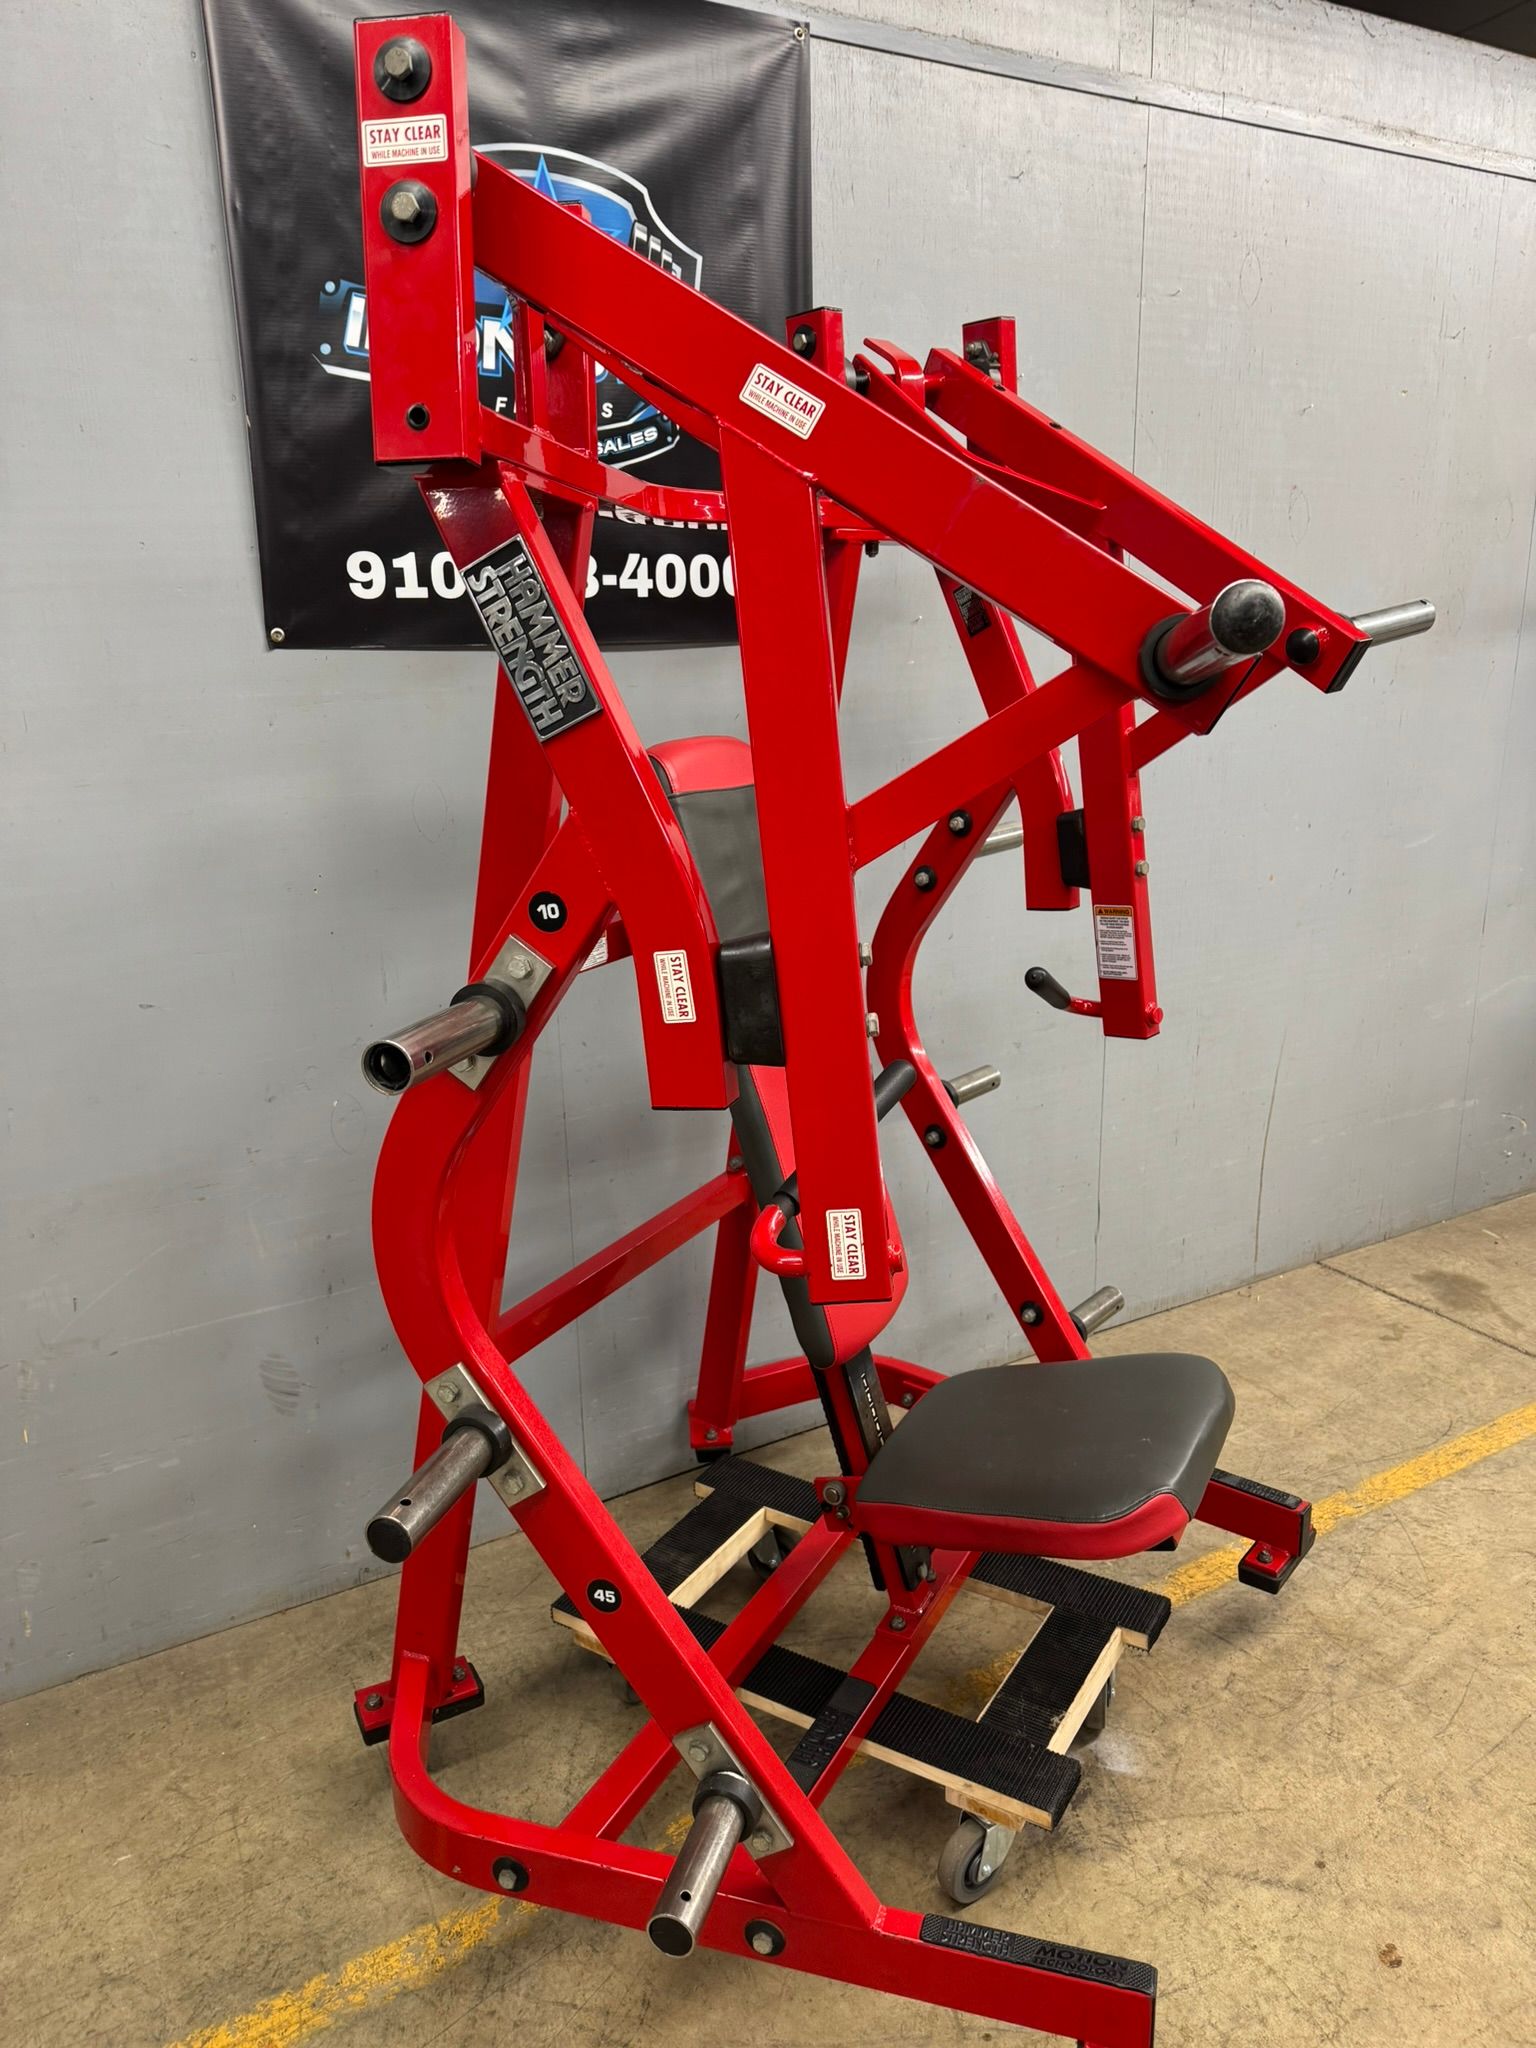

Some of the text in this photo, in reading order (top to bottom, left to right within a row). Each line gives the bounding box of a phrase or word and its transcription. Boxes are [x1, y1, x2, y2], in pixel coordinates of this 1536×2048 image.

[370, 125, 440, 144] STAY CLEAR
[371, 146, 440, 159] WHILE MACHINE IN USE
[748, 390, 807, 430] WHILE MACHINE IN USE
[754, 372, 816, 418] STAY CLEAR
[467, 565, 564, 730] STRENGTH
[496, 552, 587, 708] HAMMER
[536, 903, 560, 920] 10
[670, 956, 689, 1017] STAY CLEAR
[844, 1215, 860, 1274] STAY CLEAR
[594, 1589, 615, 1603] 45
[1036, 1945, 1129, 1971] MOTION
